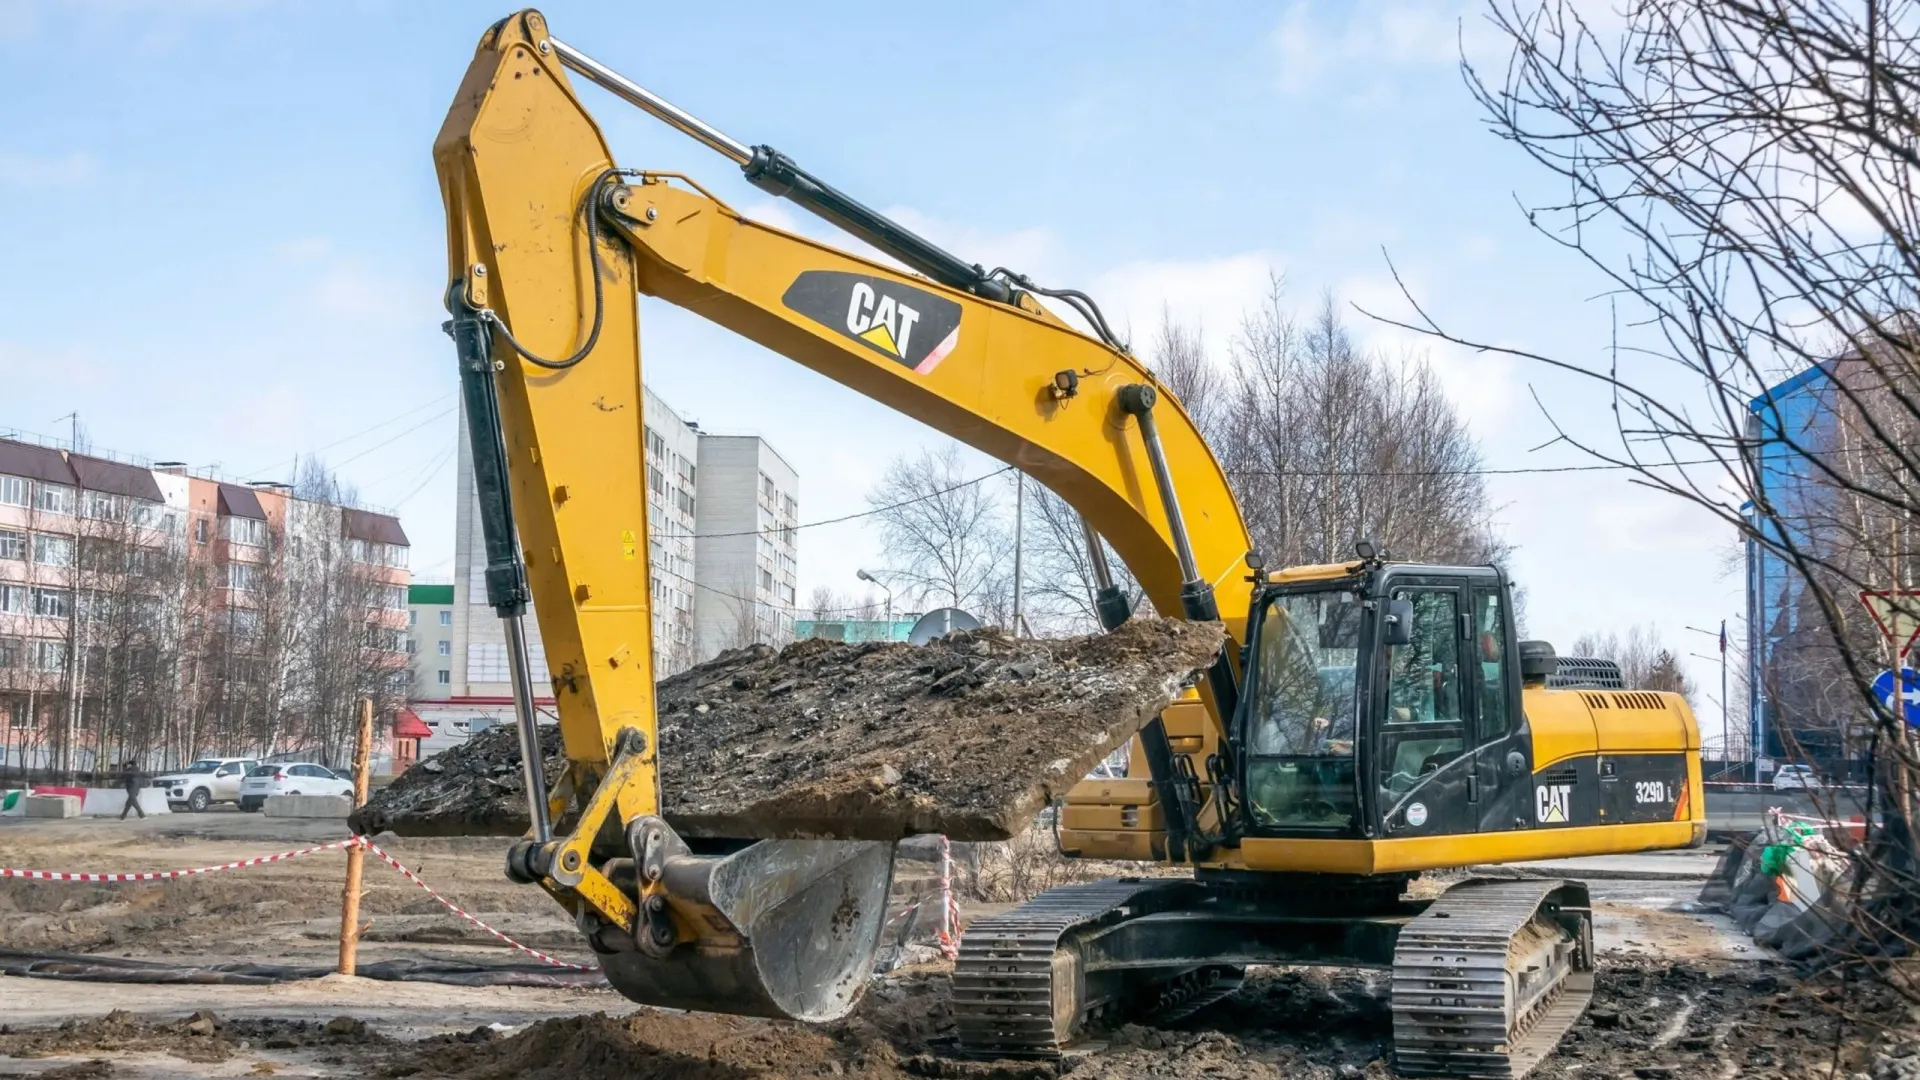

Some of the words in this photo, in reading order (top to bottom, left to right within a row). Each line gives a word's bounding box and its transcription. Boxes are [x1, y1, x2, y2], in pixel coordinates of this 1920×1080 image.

[847, 282, 920, 359] CAT
[1536, 785, 1571, 822] CAT
[1635, 782, 1664, 803] 329D
[1667, 786, 1674, 803] L
